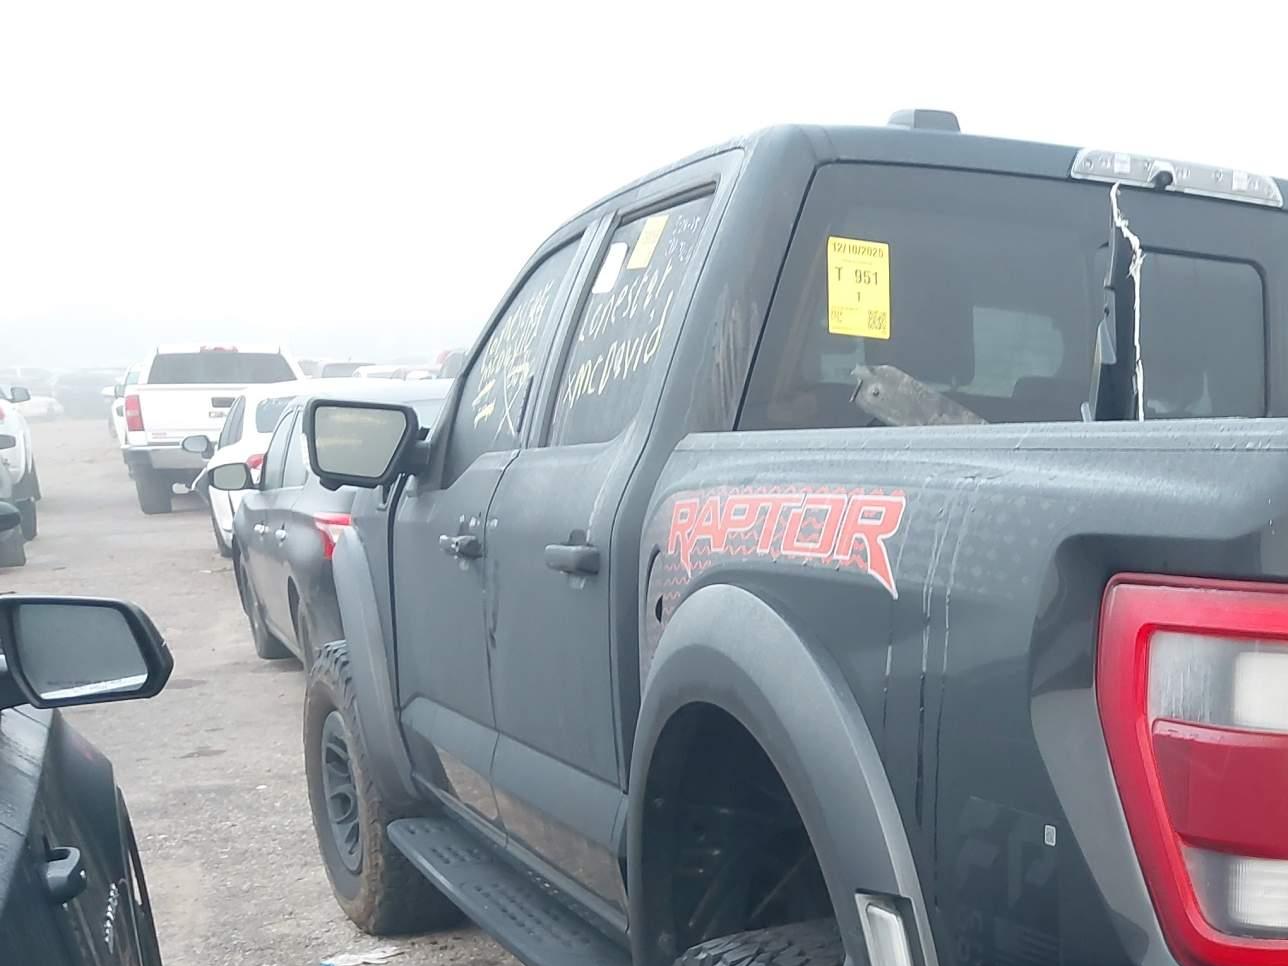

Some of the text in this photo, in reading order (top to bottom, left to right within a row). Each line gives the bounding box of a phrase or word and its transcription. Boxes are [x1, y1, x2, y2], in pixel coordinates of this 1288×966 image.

[832, 242, 884, 258] 12/10/2025
[835, 266, 879, 286] T 951
[667, 494, 907, 600] RAPTOR
